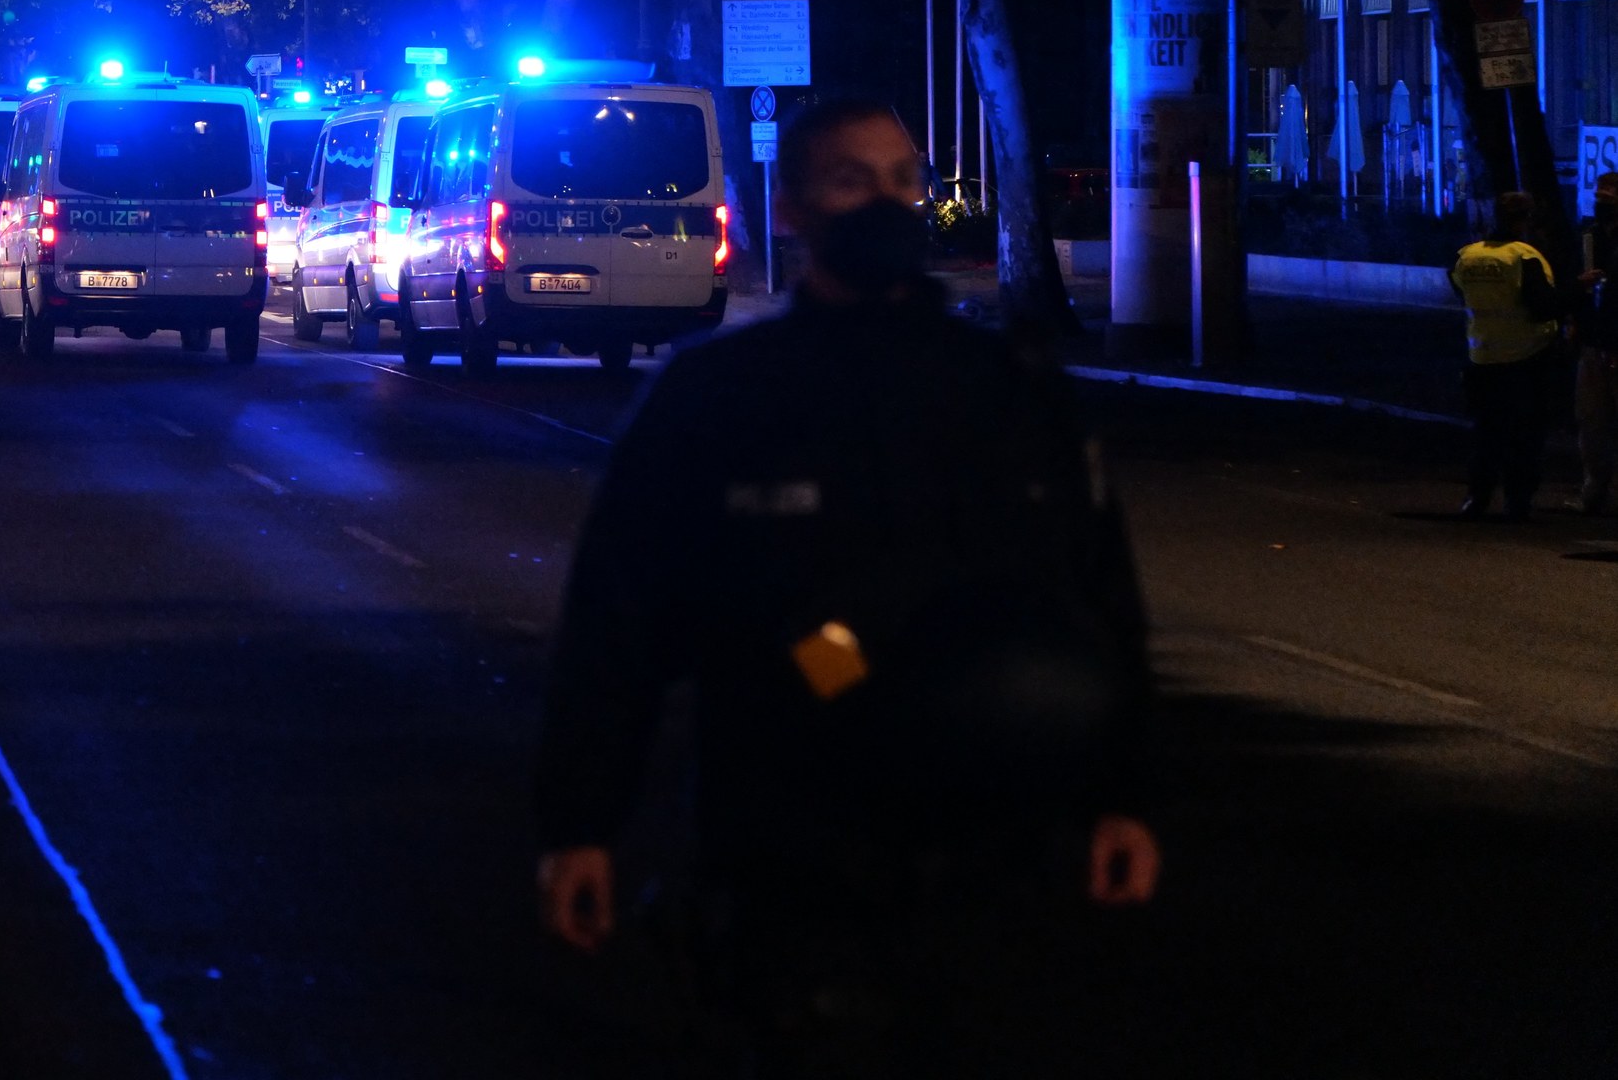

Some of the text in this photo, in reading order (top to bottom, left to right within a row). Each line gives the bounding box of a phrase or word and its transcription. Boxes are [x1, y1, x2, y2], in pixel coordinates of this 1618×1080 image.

[511, 210, 595, 227] POLIZEI
[665, 251, 678, 260] D1
[88, 276, 128, 287] B 7778
[539, 279, 582, 290] B 7404
